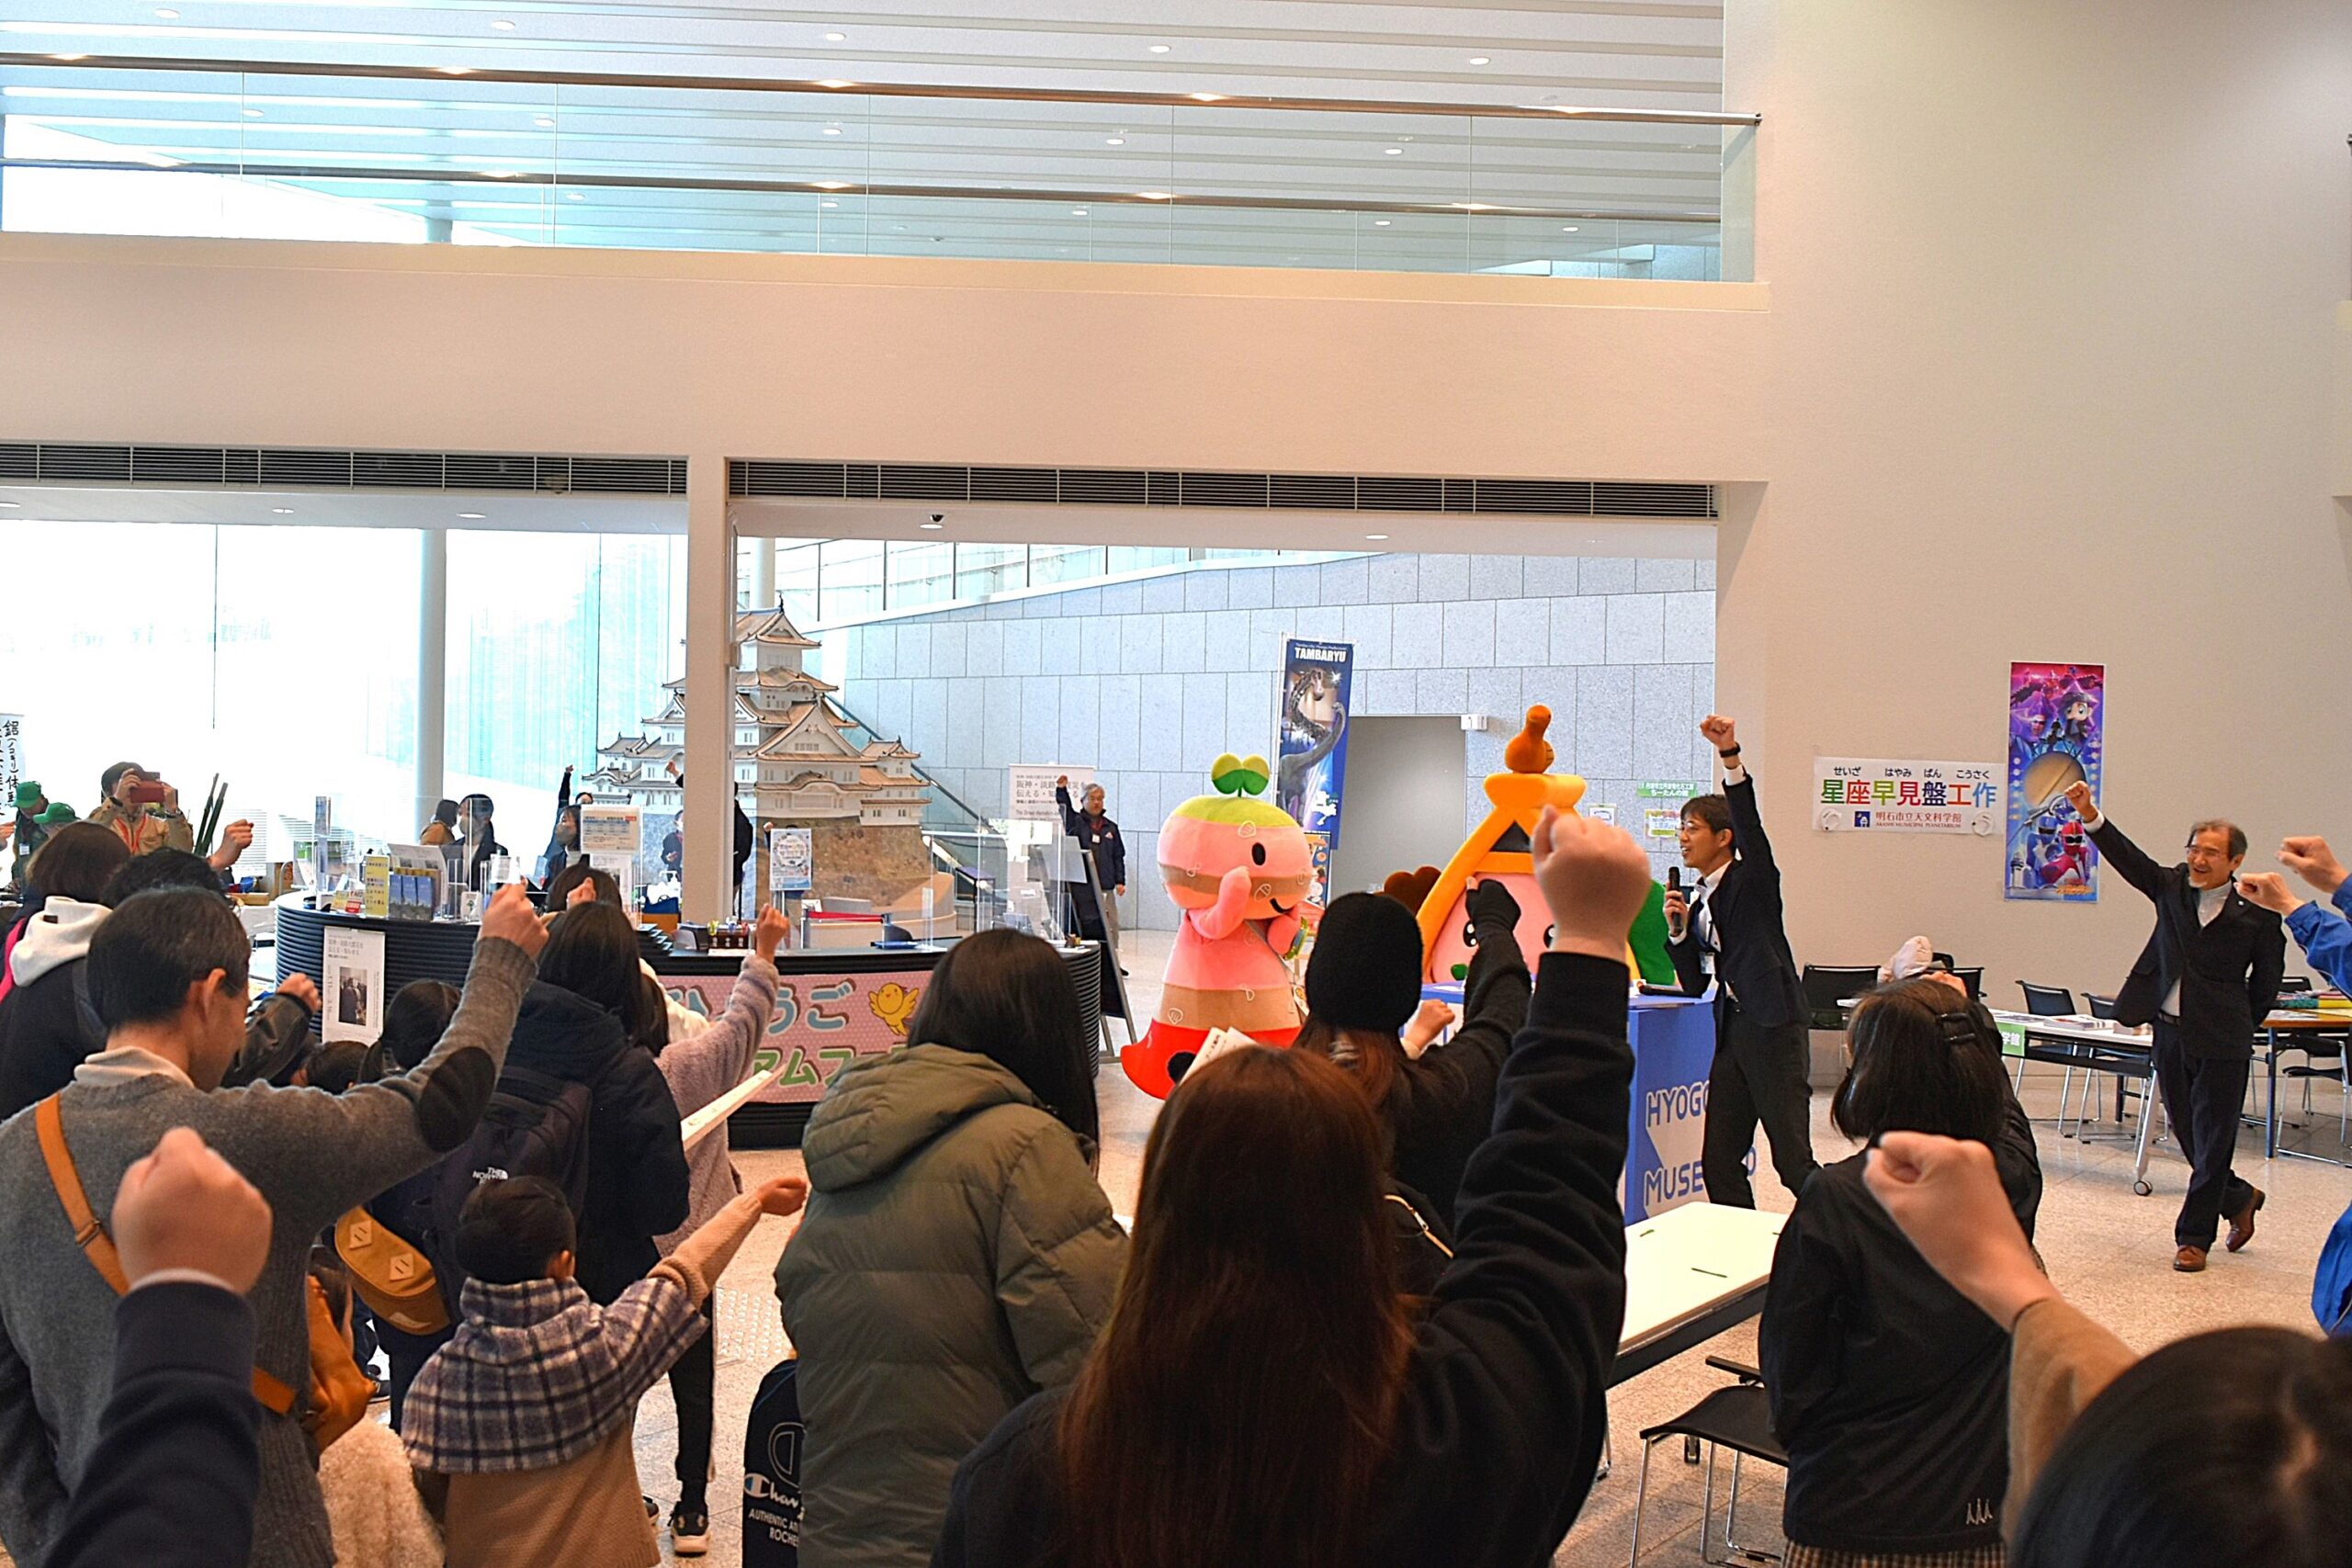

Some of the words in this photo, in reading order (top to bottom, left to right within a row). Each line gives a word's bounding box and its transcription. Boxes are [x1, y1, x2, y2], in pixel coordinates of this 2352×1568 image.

[1295, 648, 1347, 662] TAMBARYU
[1834, 766, 1861, 776] せいざ
[1884, 768, 1912, 778] はやみ
[1956, 770, 1990, 780] こうさく
[1821, 779, 1997, 808] 星座早見盤工作
[1875, 811, 1962, 823] 明石市立天文科学館
[1645, 1159, 1703, 1206] MUSE
[749, 1508, 787, 1529] AUTHENTIC
